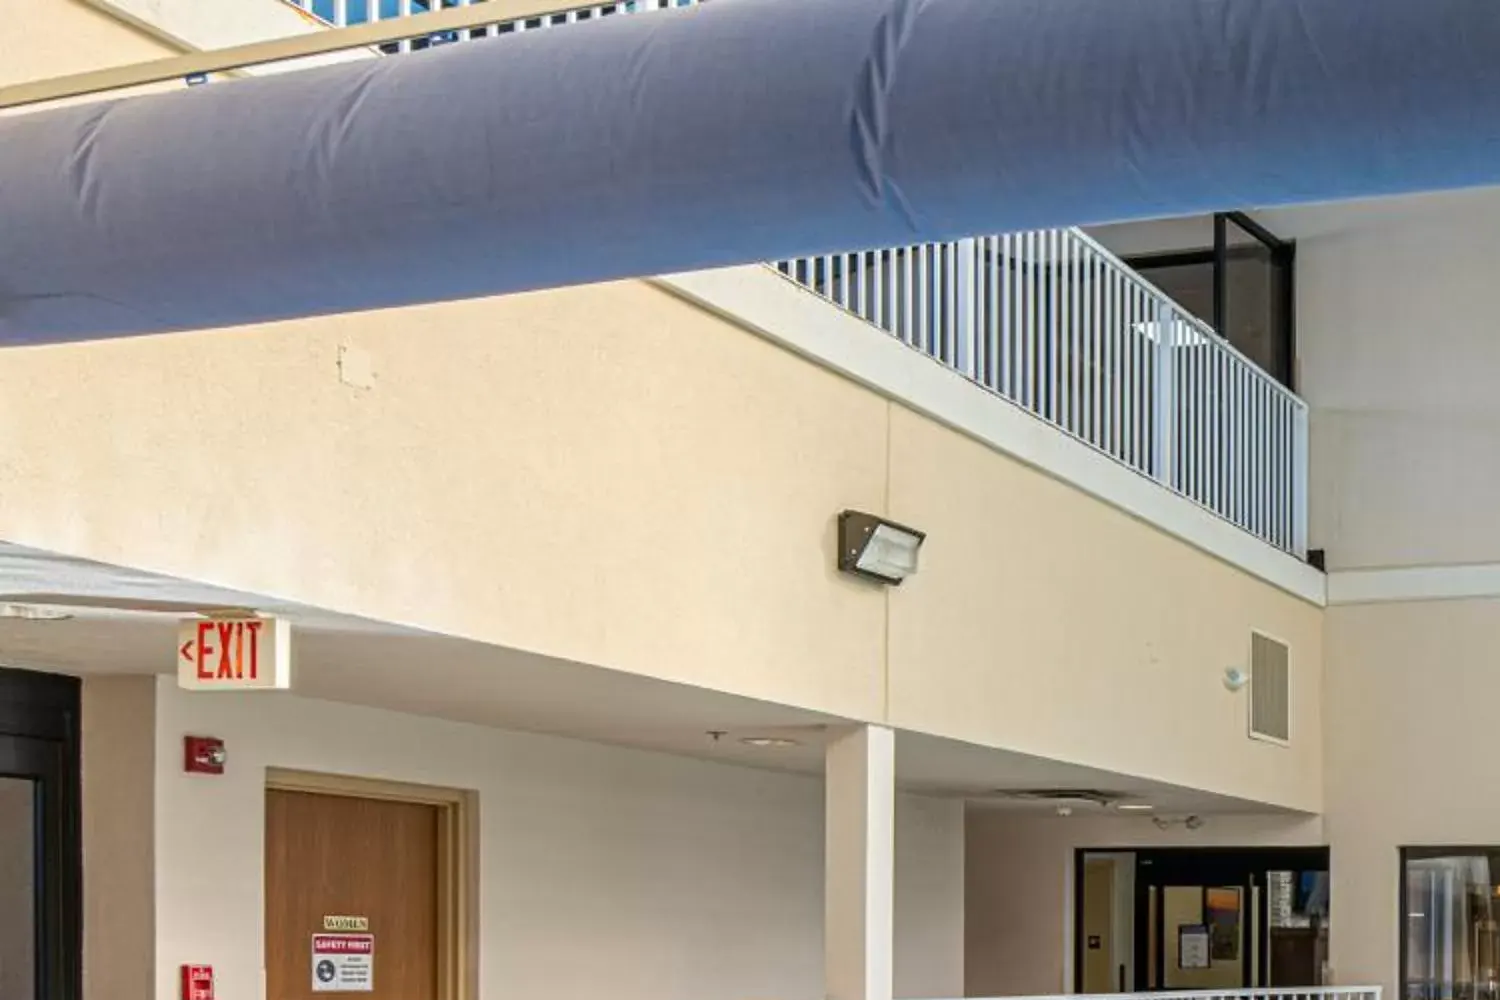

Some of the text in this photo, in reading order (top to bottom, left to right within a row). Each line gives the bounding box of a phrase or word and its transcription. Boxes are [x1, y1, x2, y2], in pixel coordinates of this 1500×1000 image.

[197, 621, 262, 679] EXIT
[325, 918, 367, 929] WOMEN
[315, 939, 346, 949] SAFETY
